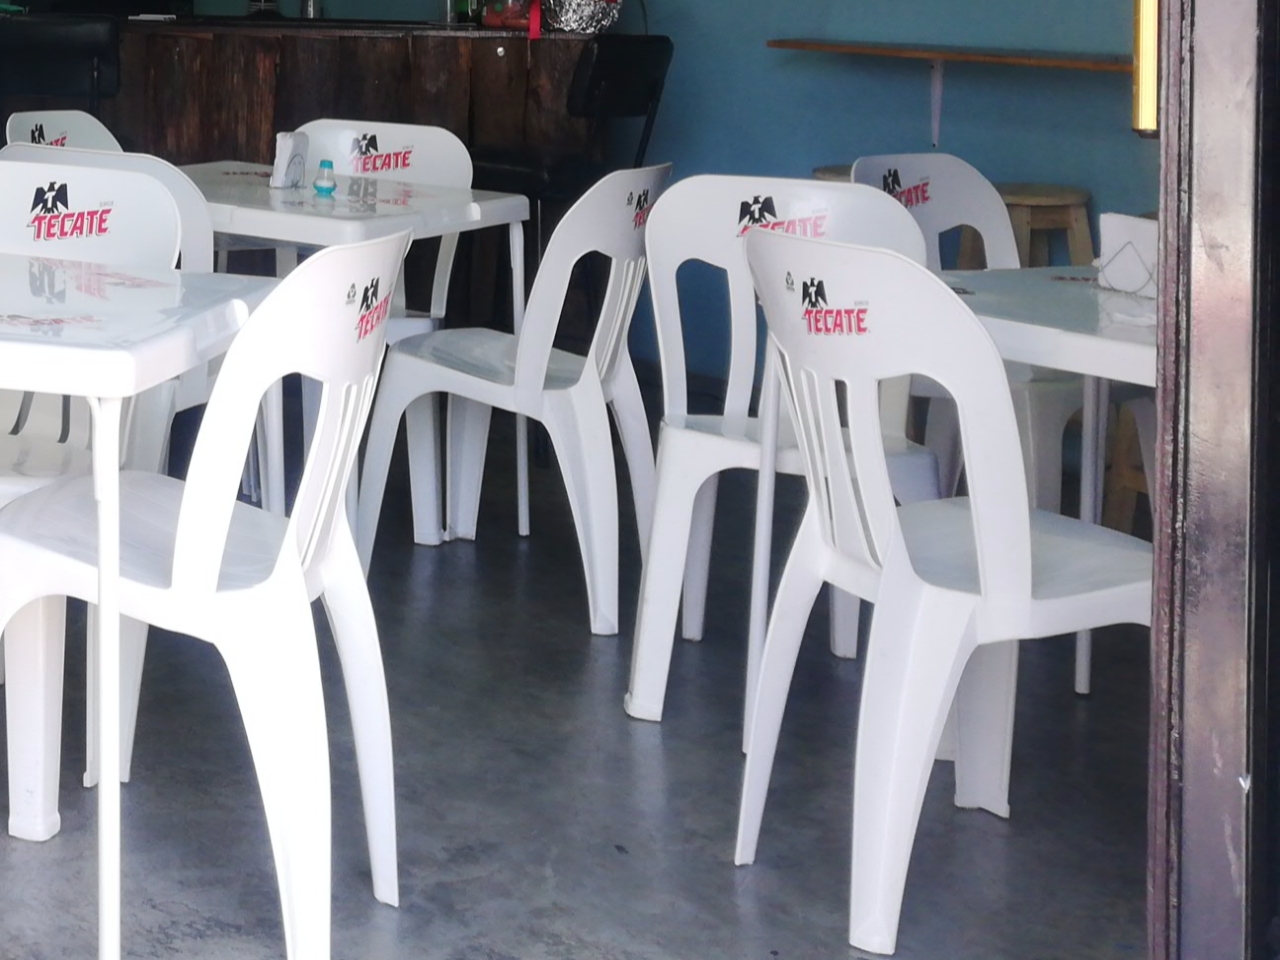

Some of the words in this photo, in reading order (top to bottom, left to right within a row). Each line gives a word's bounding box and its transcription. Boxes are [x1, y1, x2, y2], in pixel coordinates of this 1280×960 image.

[350, 150, 413, 172] TECATE
[27, 208, 112, 241] TECATE
[802, 307, 869, 335] TECATE
